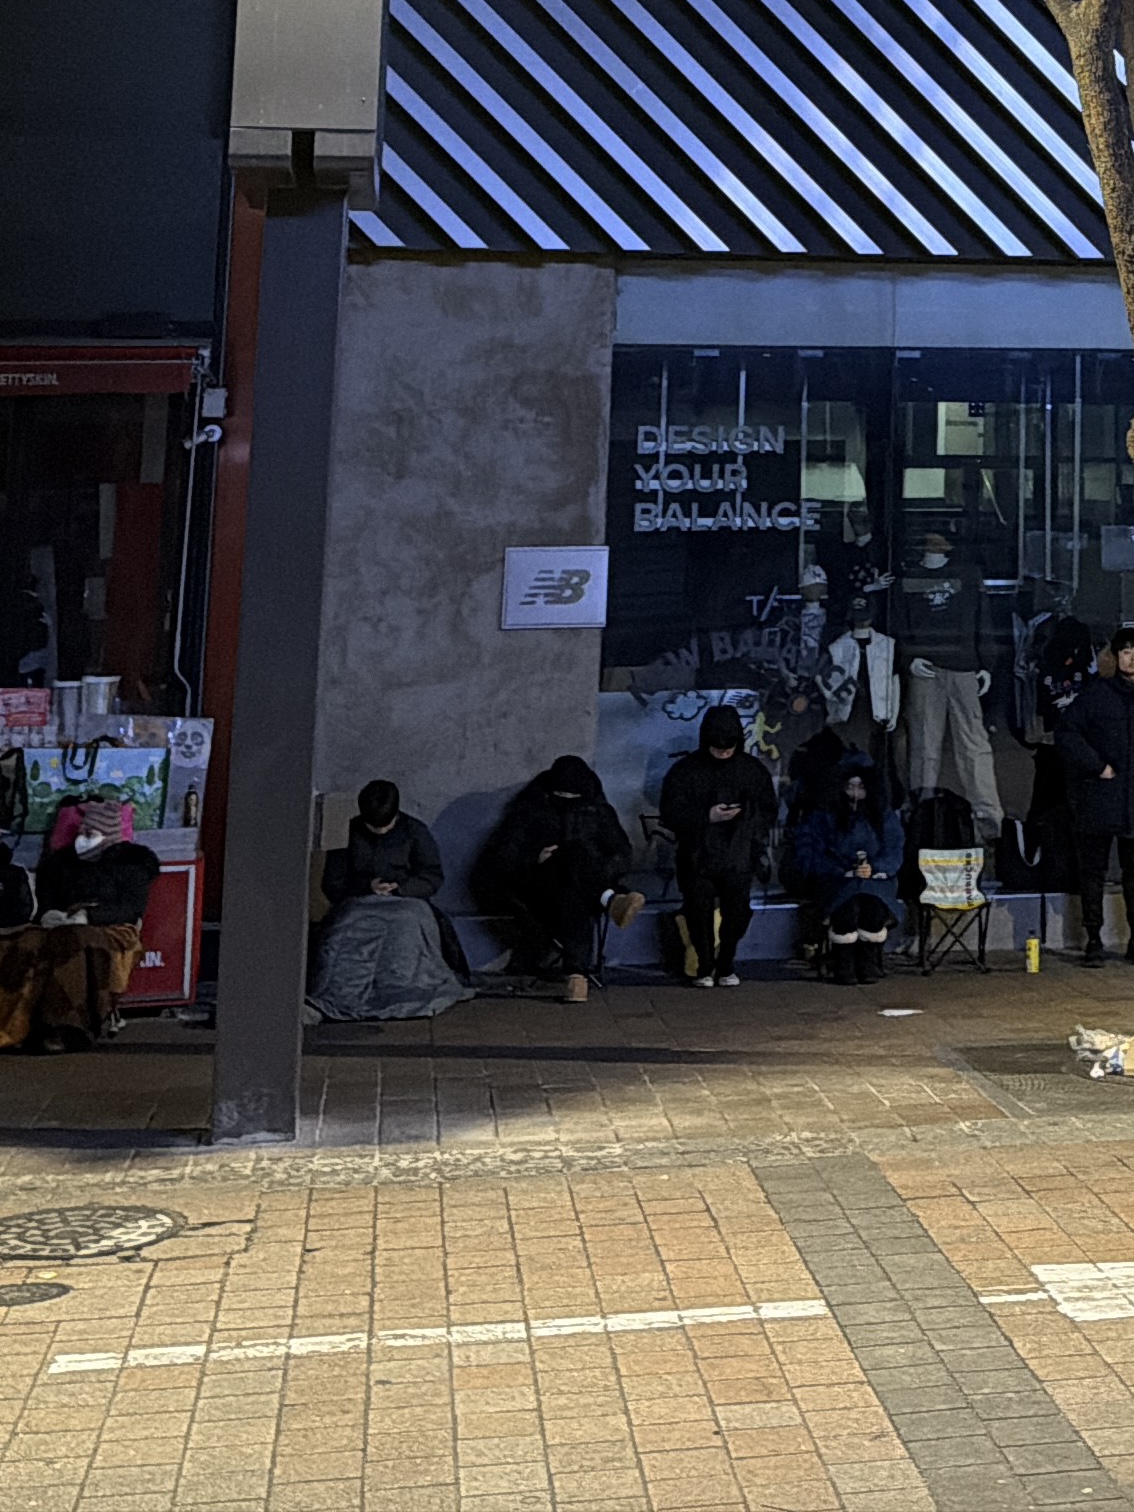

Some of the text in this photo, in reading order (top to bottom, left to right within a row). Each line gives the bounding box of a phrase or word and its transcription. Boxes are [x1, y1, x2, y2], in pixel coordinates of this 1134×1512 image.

[637, 425, 786, 455] DESIGN
[633, 463, 748, 493] YOUR
[633, 501, 822, 532] BALANCE
[965, 851, 975, 908] TARBUCKS
